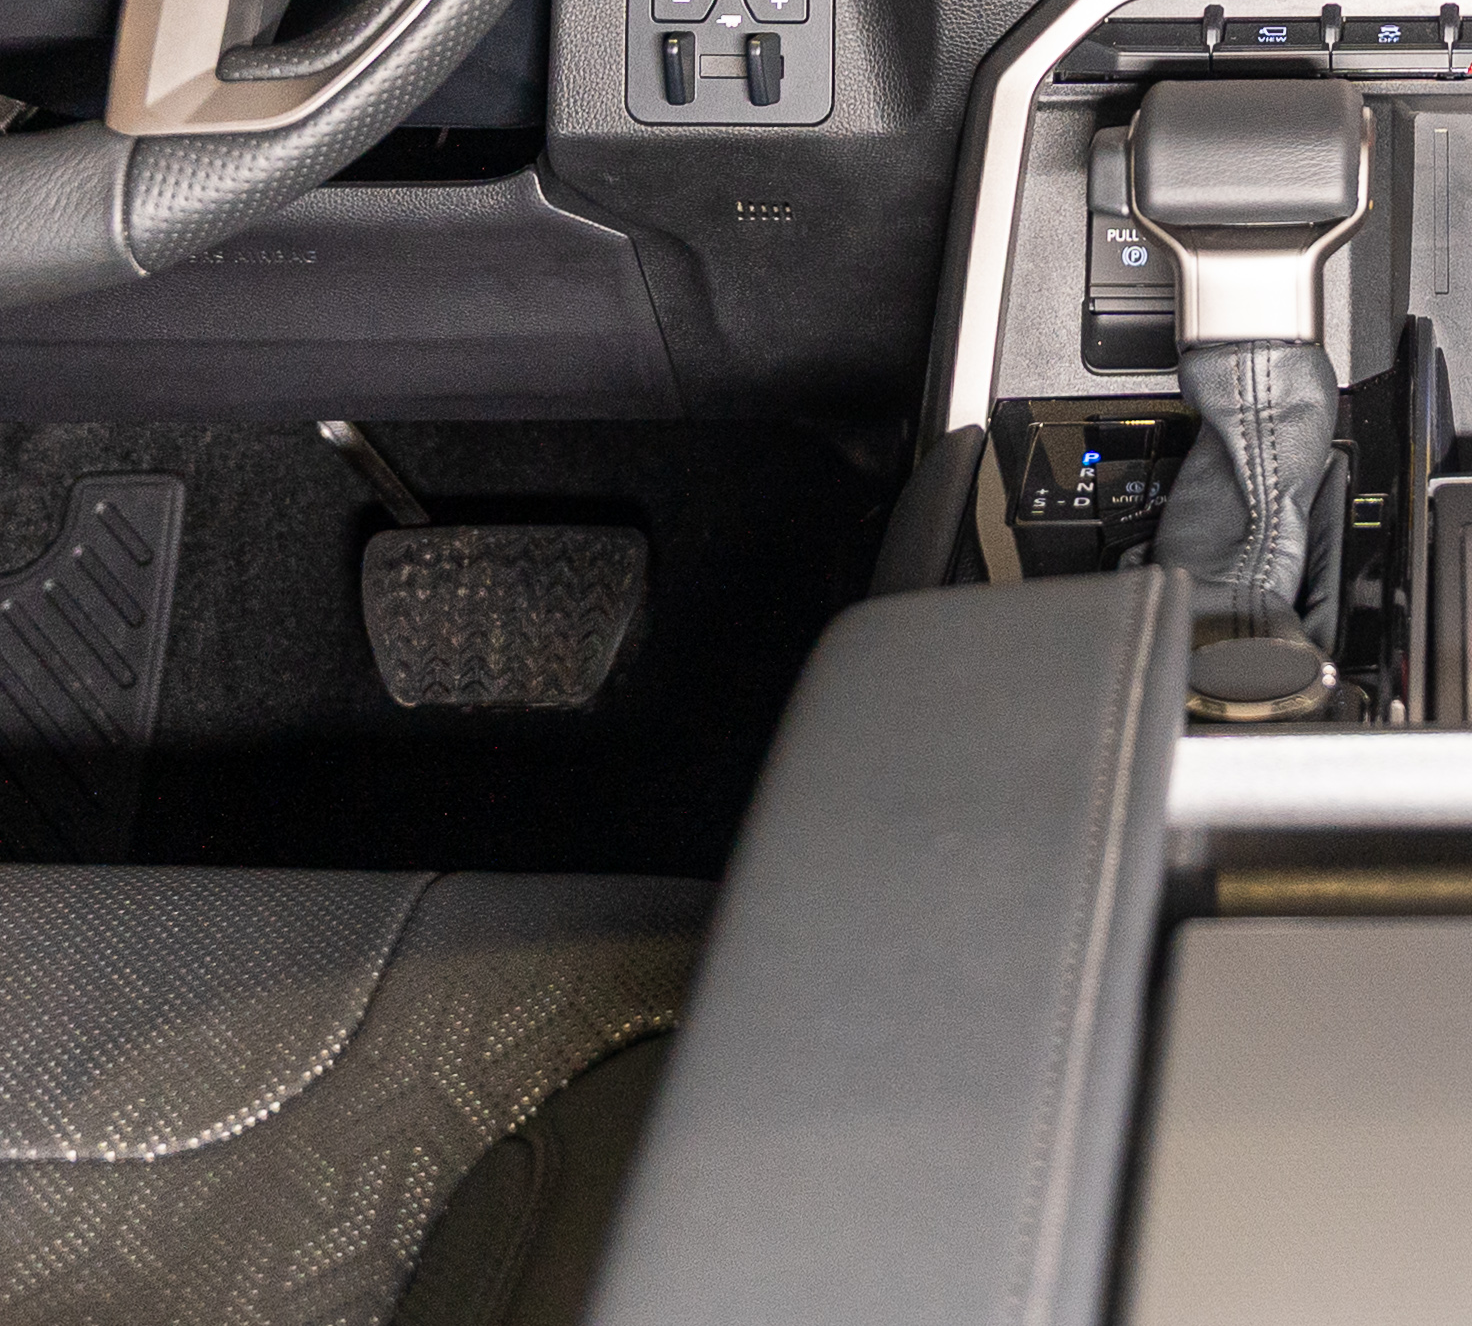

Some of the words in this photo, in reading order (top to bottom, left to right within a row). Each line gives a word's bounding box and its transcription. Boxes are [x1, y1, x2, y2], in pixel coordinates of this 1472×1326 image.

[1107, 229, 1139, 242] PULL
[1083, 452, 1101, 464] P
[1080, 468, 1095, 477] R
[1077, 483, 1094, 492] N
[1033, 498, 1047, 507] S
[1073, 498, 1091, 507] D
